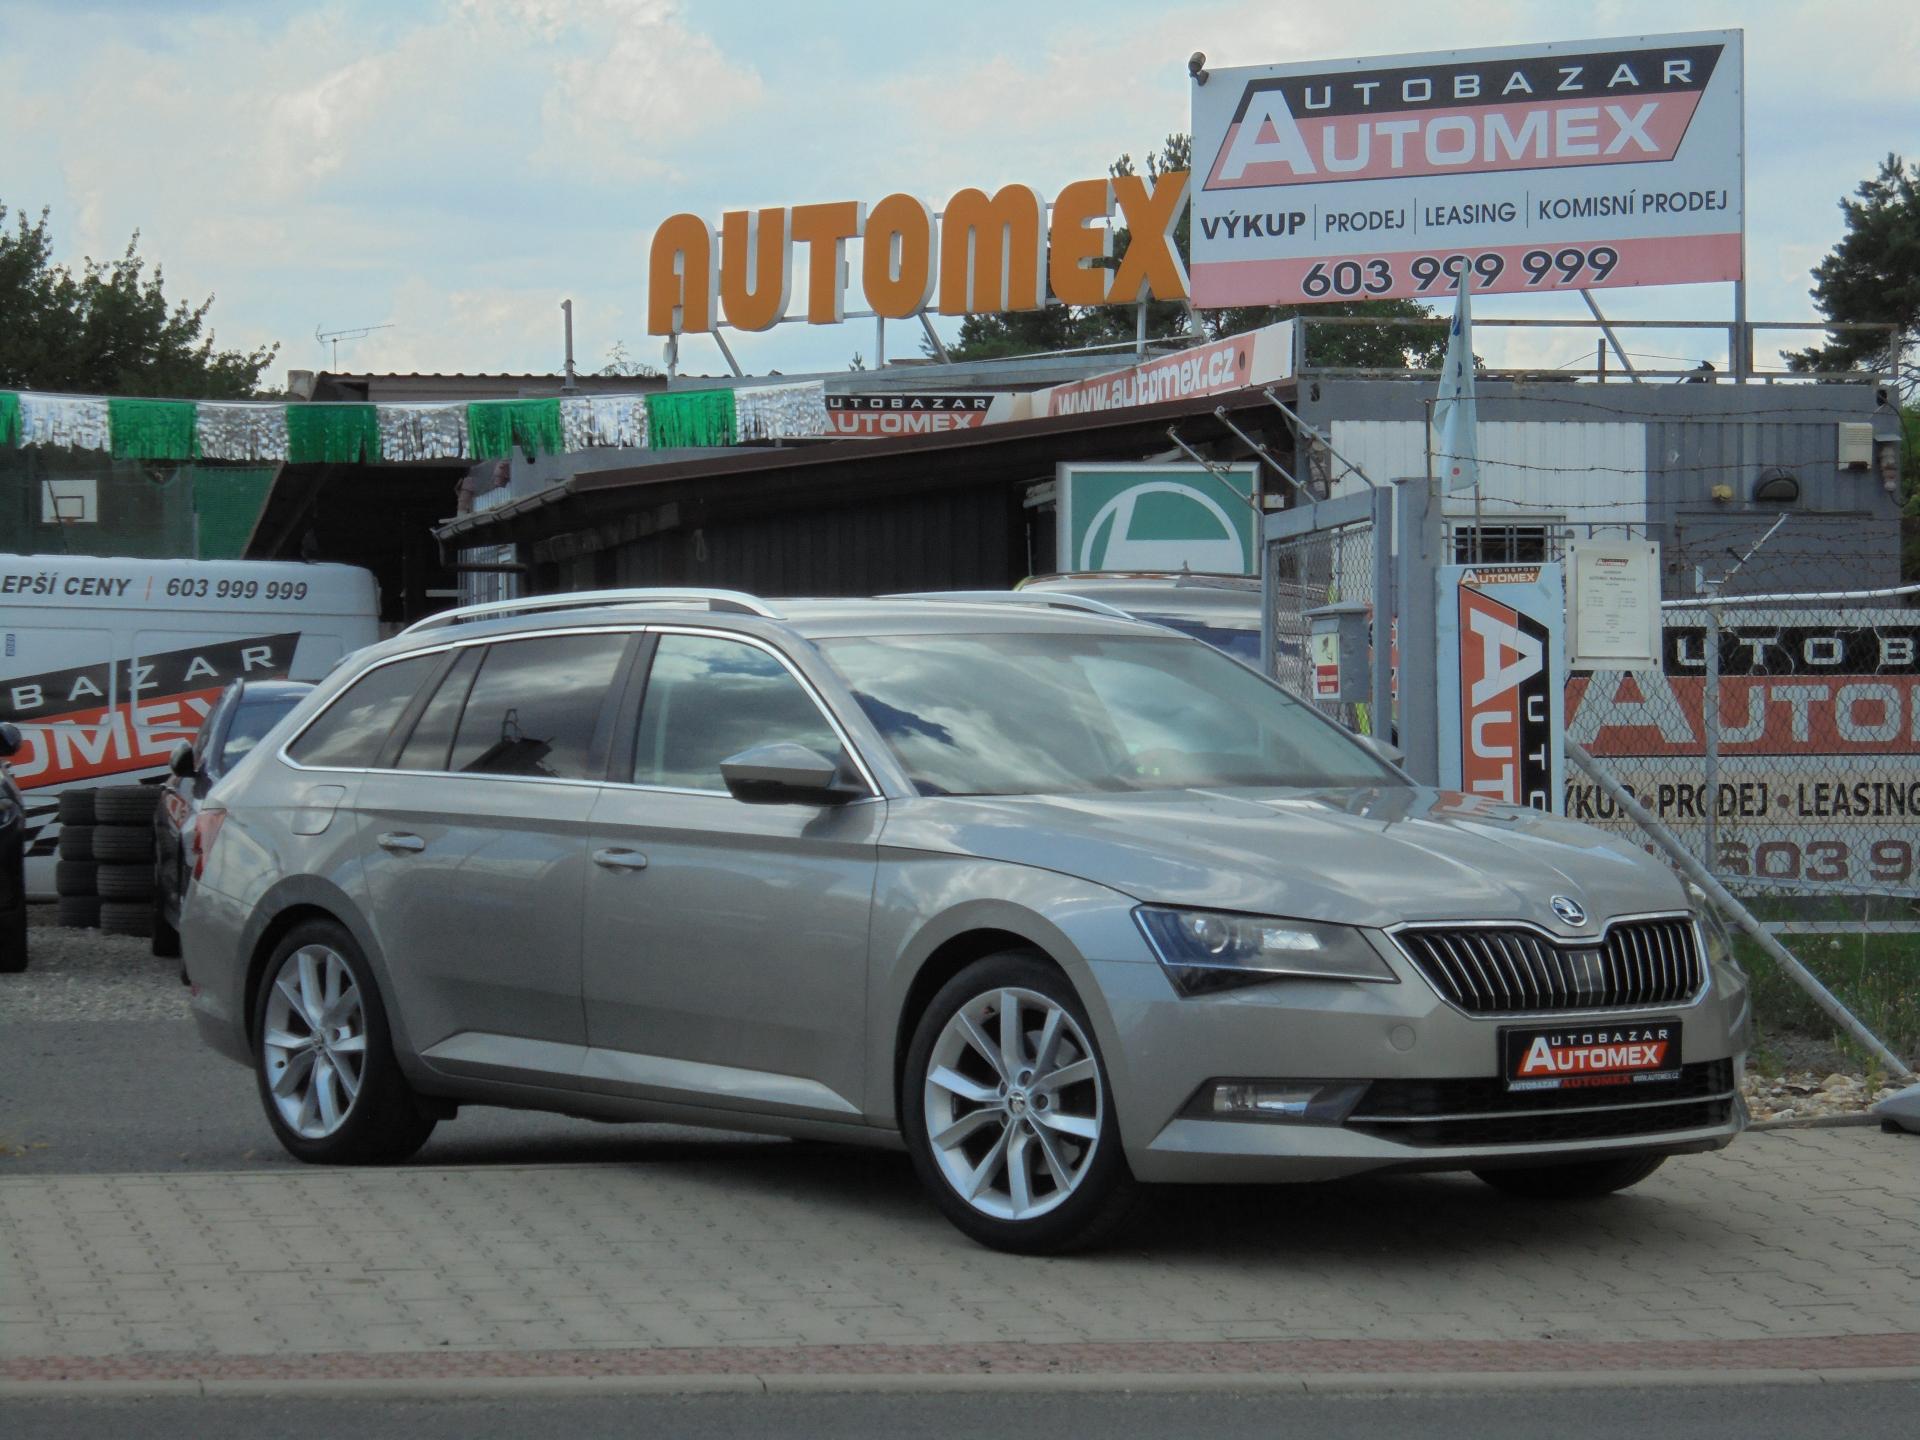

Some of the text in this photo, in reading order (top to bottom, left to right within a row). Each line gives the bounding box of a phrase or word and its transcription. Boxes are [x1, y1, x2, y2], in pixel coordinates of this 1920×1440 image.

[1218, 90, 1661, 180] AUTOMEX
[1201, 189, 1728, 241] VÝKUP PRODEJ LEASING KOMISNÍ PRODEJ
[648, 171, 1190, 336] AUTOMEX
[1302, 246, 1619, 298] 603 999 999
[1058, 347, 1236, 416] www.automex.cz
[2, 572, 308, 600] EPŠÍ CENY 603 999 999
[1460, 569, 1536, 584] AUTOMEX
[1567, 670, 1920, 745] AUTO
[1798, 782, 1920, 817] LEASING
[1714, 840, 1849, 881] 603
[1523, 1036, 1658, 1073] AUTOMEX
[1561, 1075, 1631, 1088] AUTOMEX
